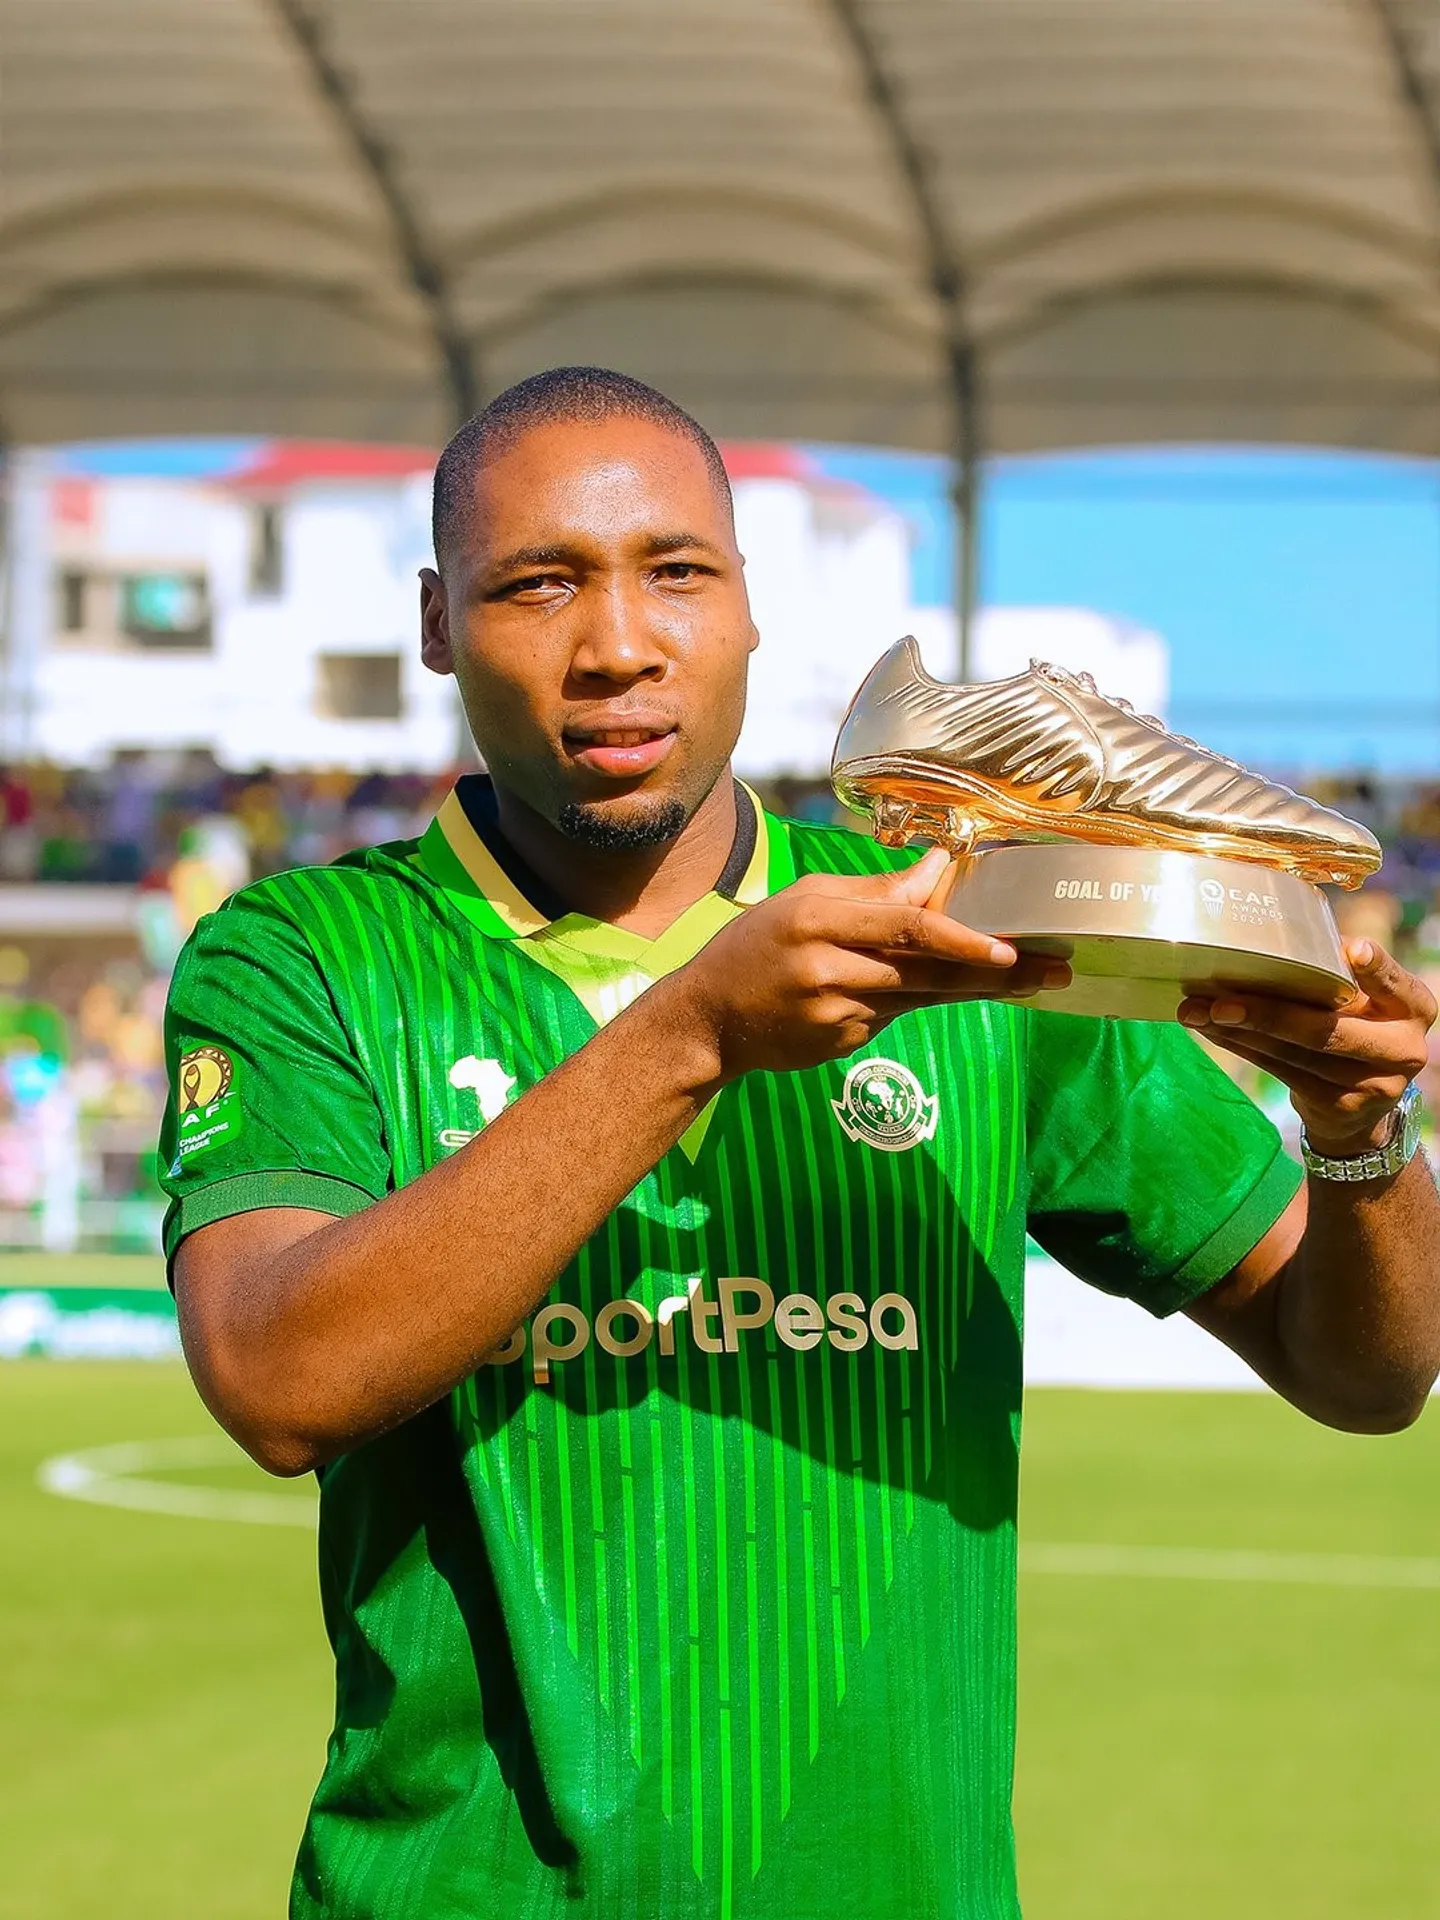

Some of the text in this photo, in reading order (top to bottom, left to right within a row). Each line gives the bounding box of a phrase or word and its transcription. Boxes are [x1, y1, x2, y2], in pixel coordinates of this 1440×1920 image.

[1054, 879, 1103, 900] GOAL
[1109, 881, 1135, 902] OF
[1231, 903, 1284, 920] AWARDS
[1232, 912, 1263, 926] 2025
[181, 1102, 220, 1128] AF
[179, 1121, 230, 1148] CHAMPIONS
[179, 1137, 211, 1156] LEAGUE
